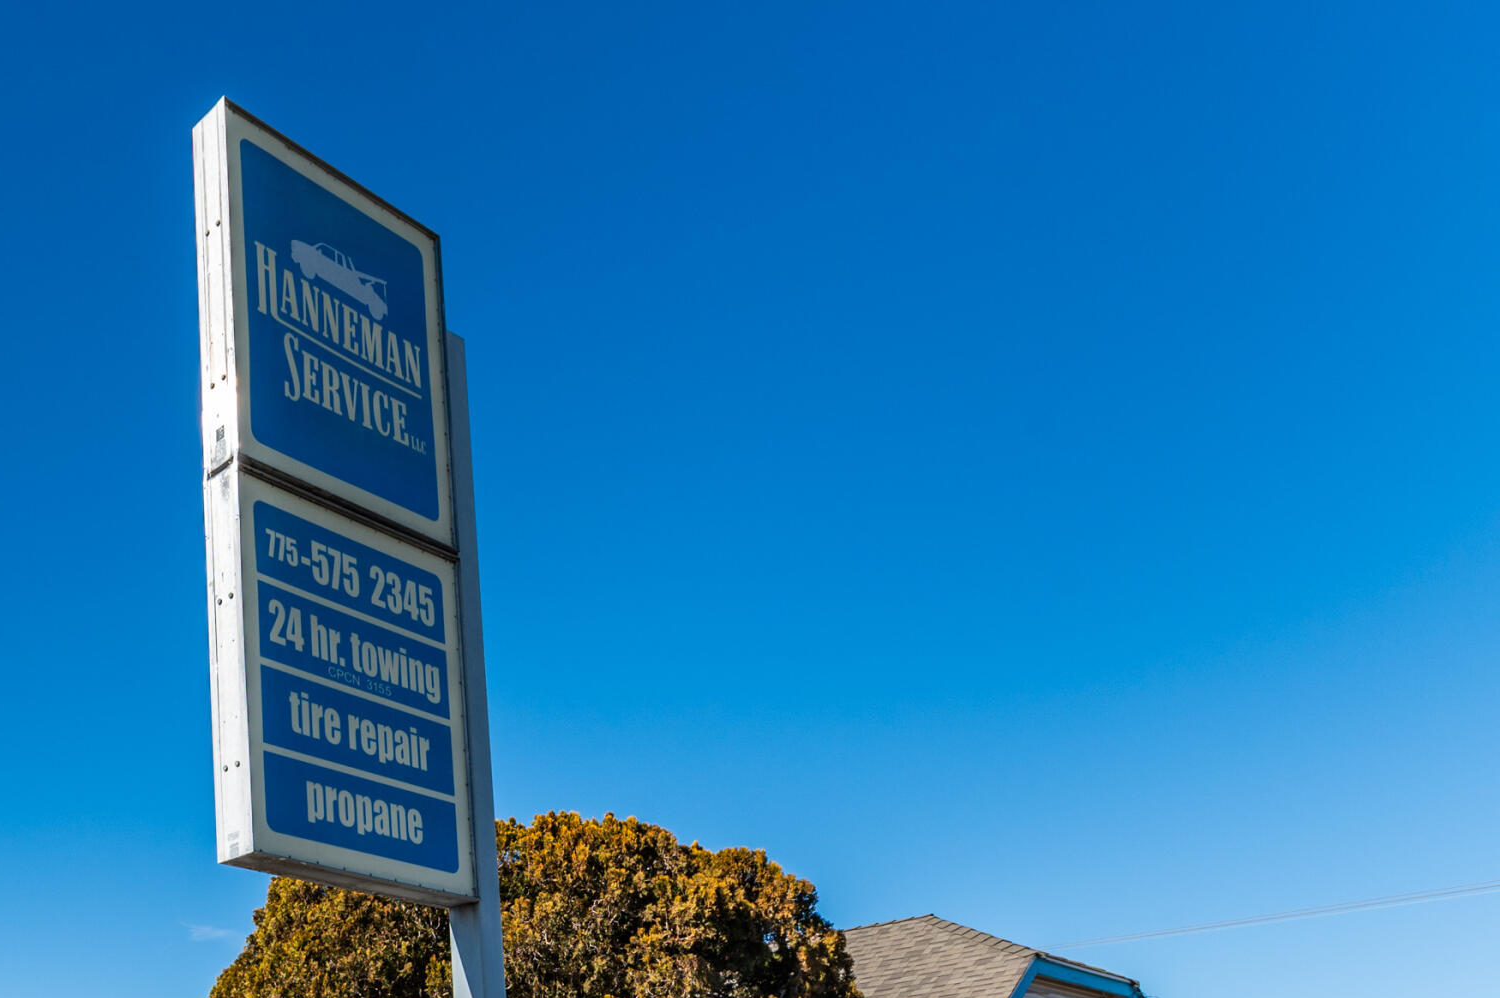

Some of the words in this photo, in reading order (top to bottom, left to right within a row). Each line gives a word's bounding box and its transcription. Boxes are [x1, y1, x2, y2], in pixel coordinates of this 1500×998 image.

[254, 241, 421, 389] HANNEMAN
[284, 331, 409, 446] SERVICE
[411, 434, 427, 456] LLC
[265, 528, 360, 598] 775-575
[369, 565, 435, 628] 2345
[268, 599, 304, 652] 24
[310, 614, 345, 664] hr.
[350, 632, 440, 704] towing
[289, 690, 341, 744] tire
[348, 714, 430, 772] repair
[306, 780, 424, 845] propane
